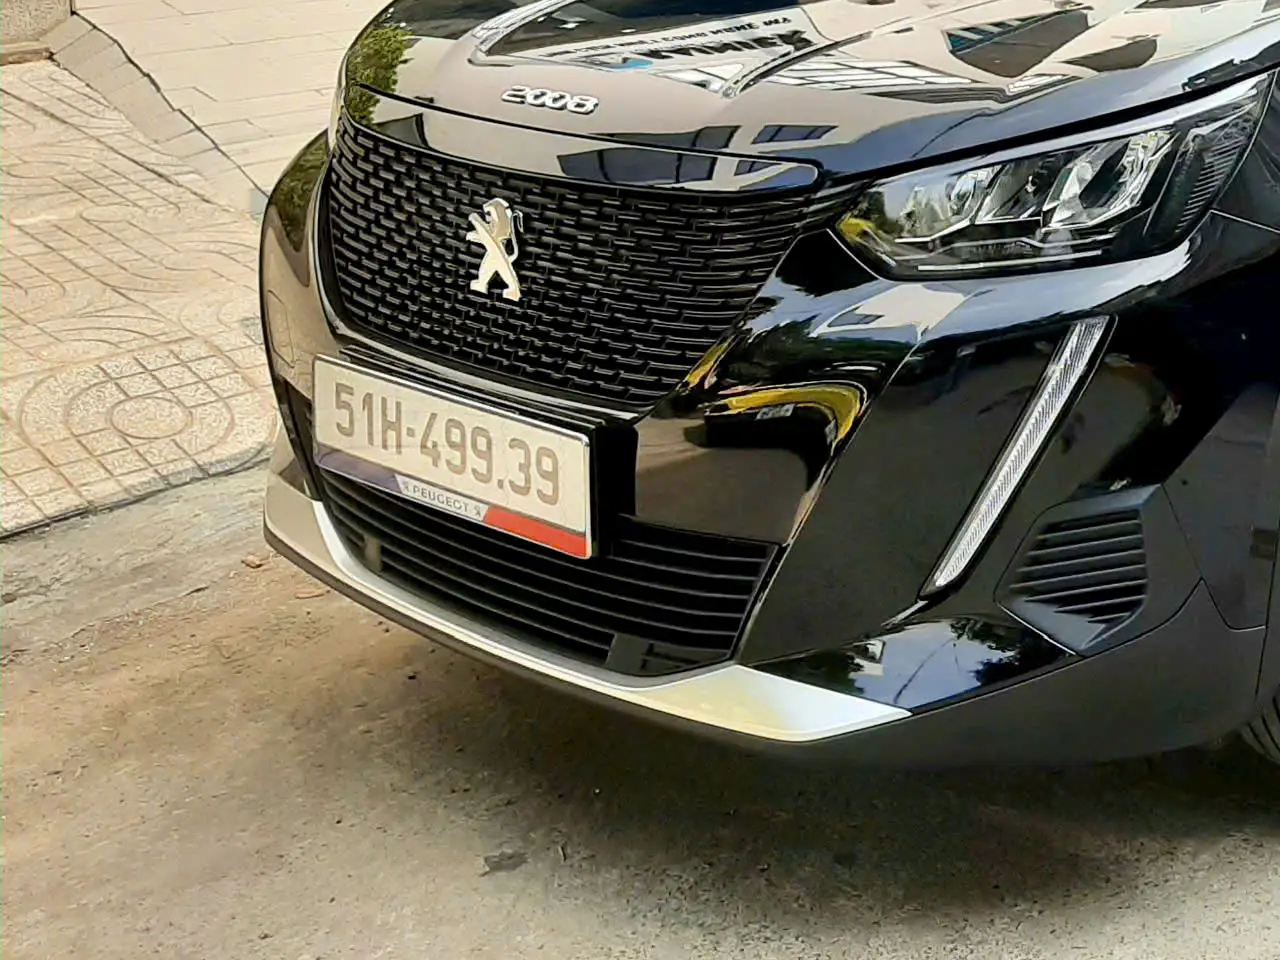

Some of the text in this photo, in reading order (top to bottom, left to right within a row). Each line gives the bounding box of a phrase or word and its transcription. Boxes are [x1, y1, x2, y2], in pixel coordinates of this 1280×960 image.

[501, 85, 600, 116] 2008
[334, 382, 560, 506] 51H-499.39
[412, 484, 469, 513] PEUGEOT
